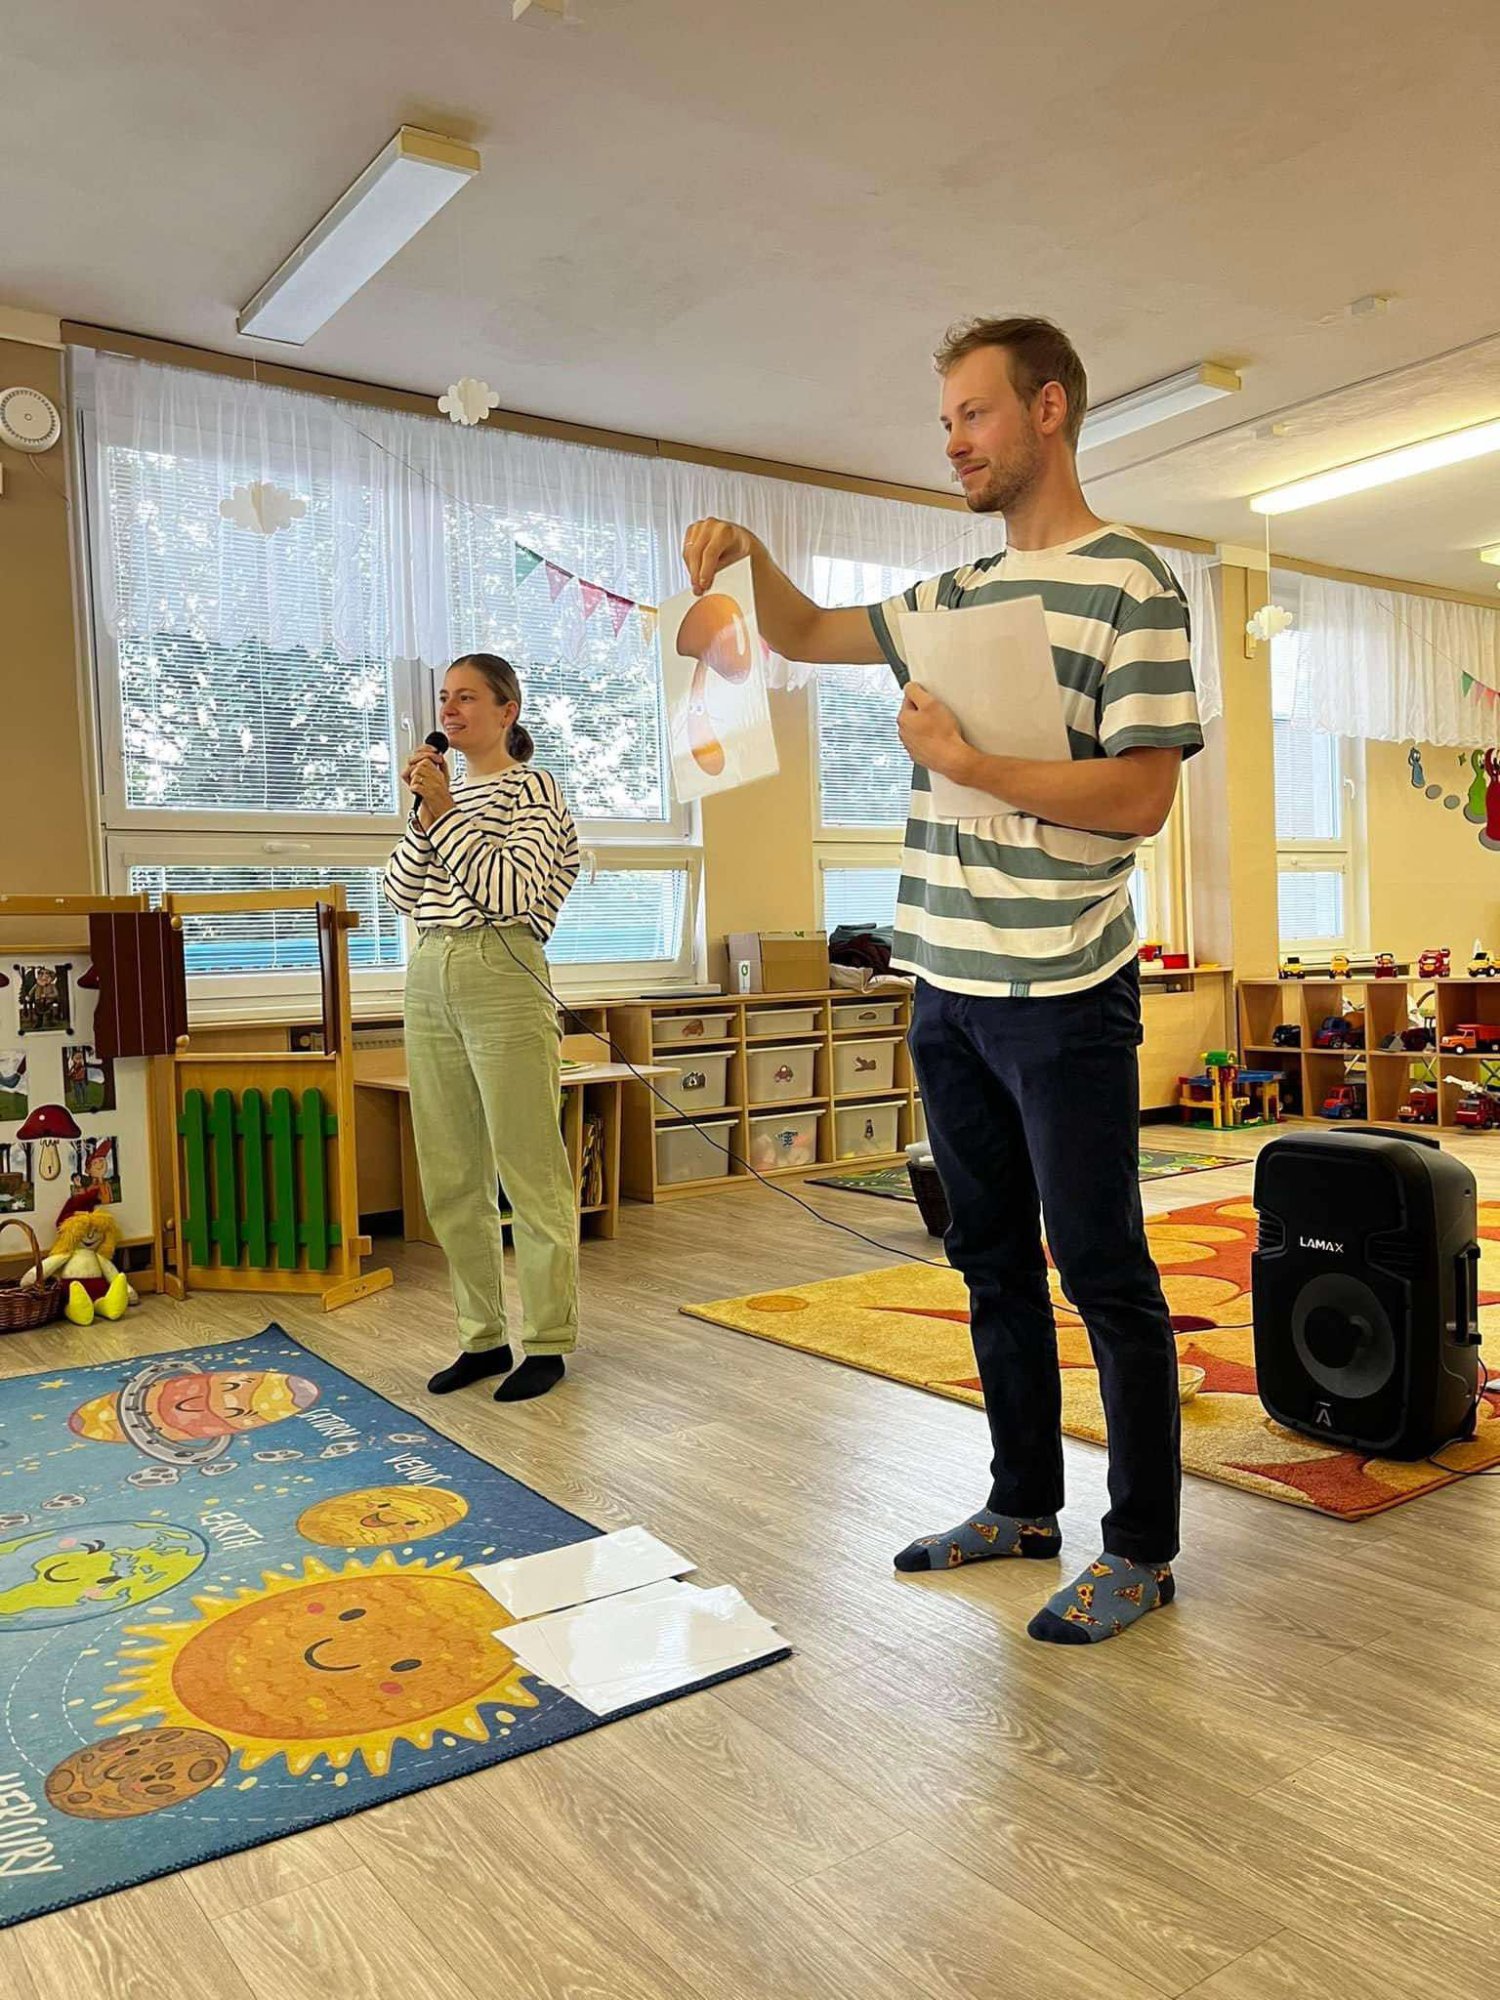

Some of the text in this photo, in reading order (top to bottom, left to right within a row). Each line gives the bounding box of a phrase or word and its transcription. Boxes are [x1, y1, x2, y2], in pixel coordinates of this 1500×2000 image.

[1299, 1235, 1345, 1254] LAMAX
[296, 1407, 362, 1440] SATURN
[383, 1452, 452, 1487] VENUS
[200, 1511, 265, 1552] EARTH
